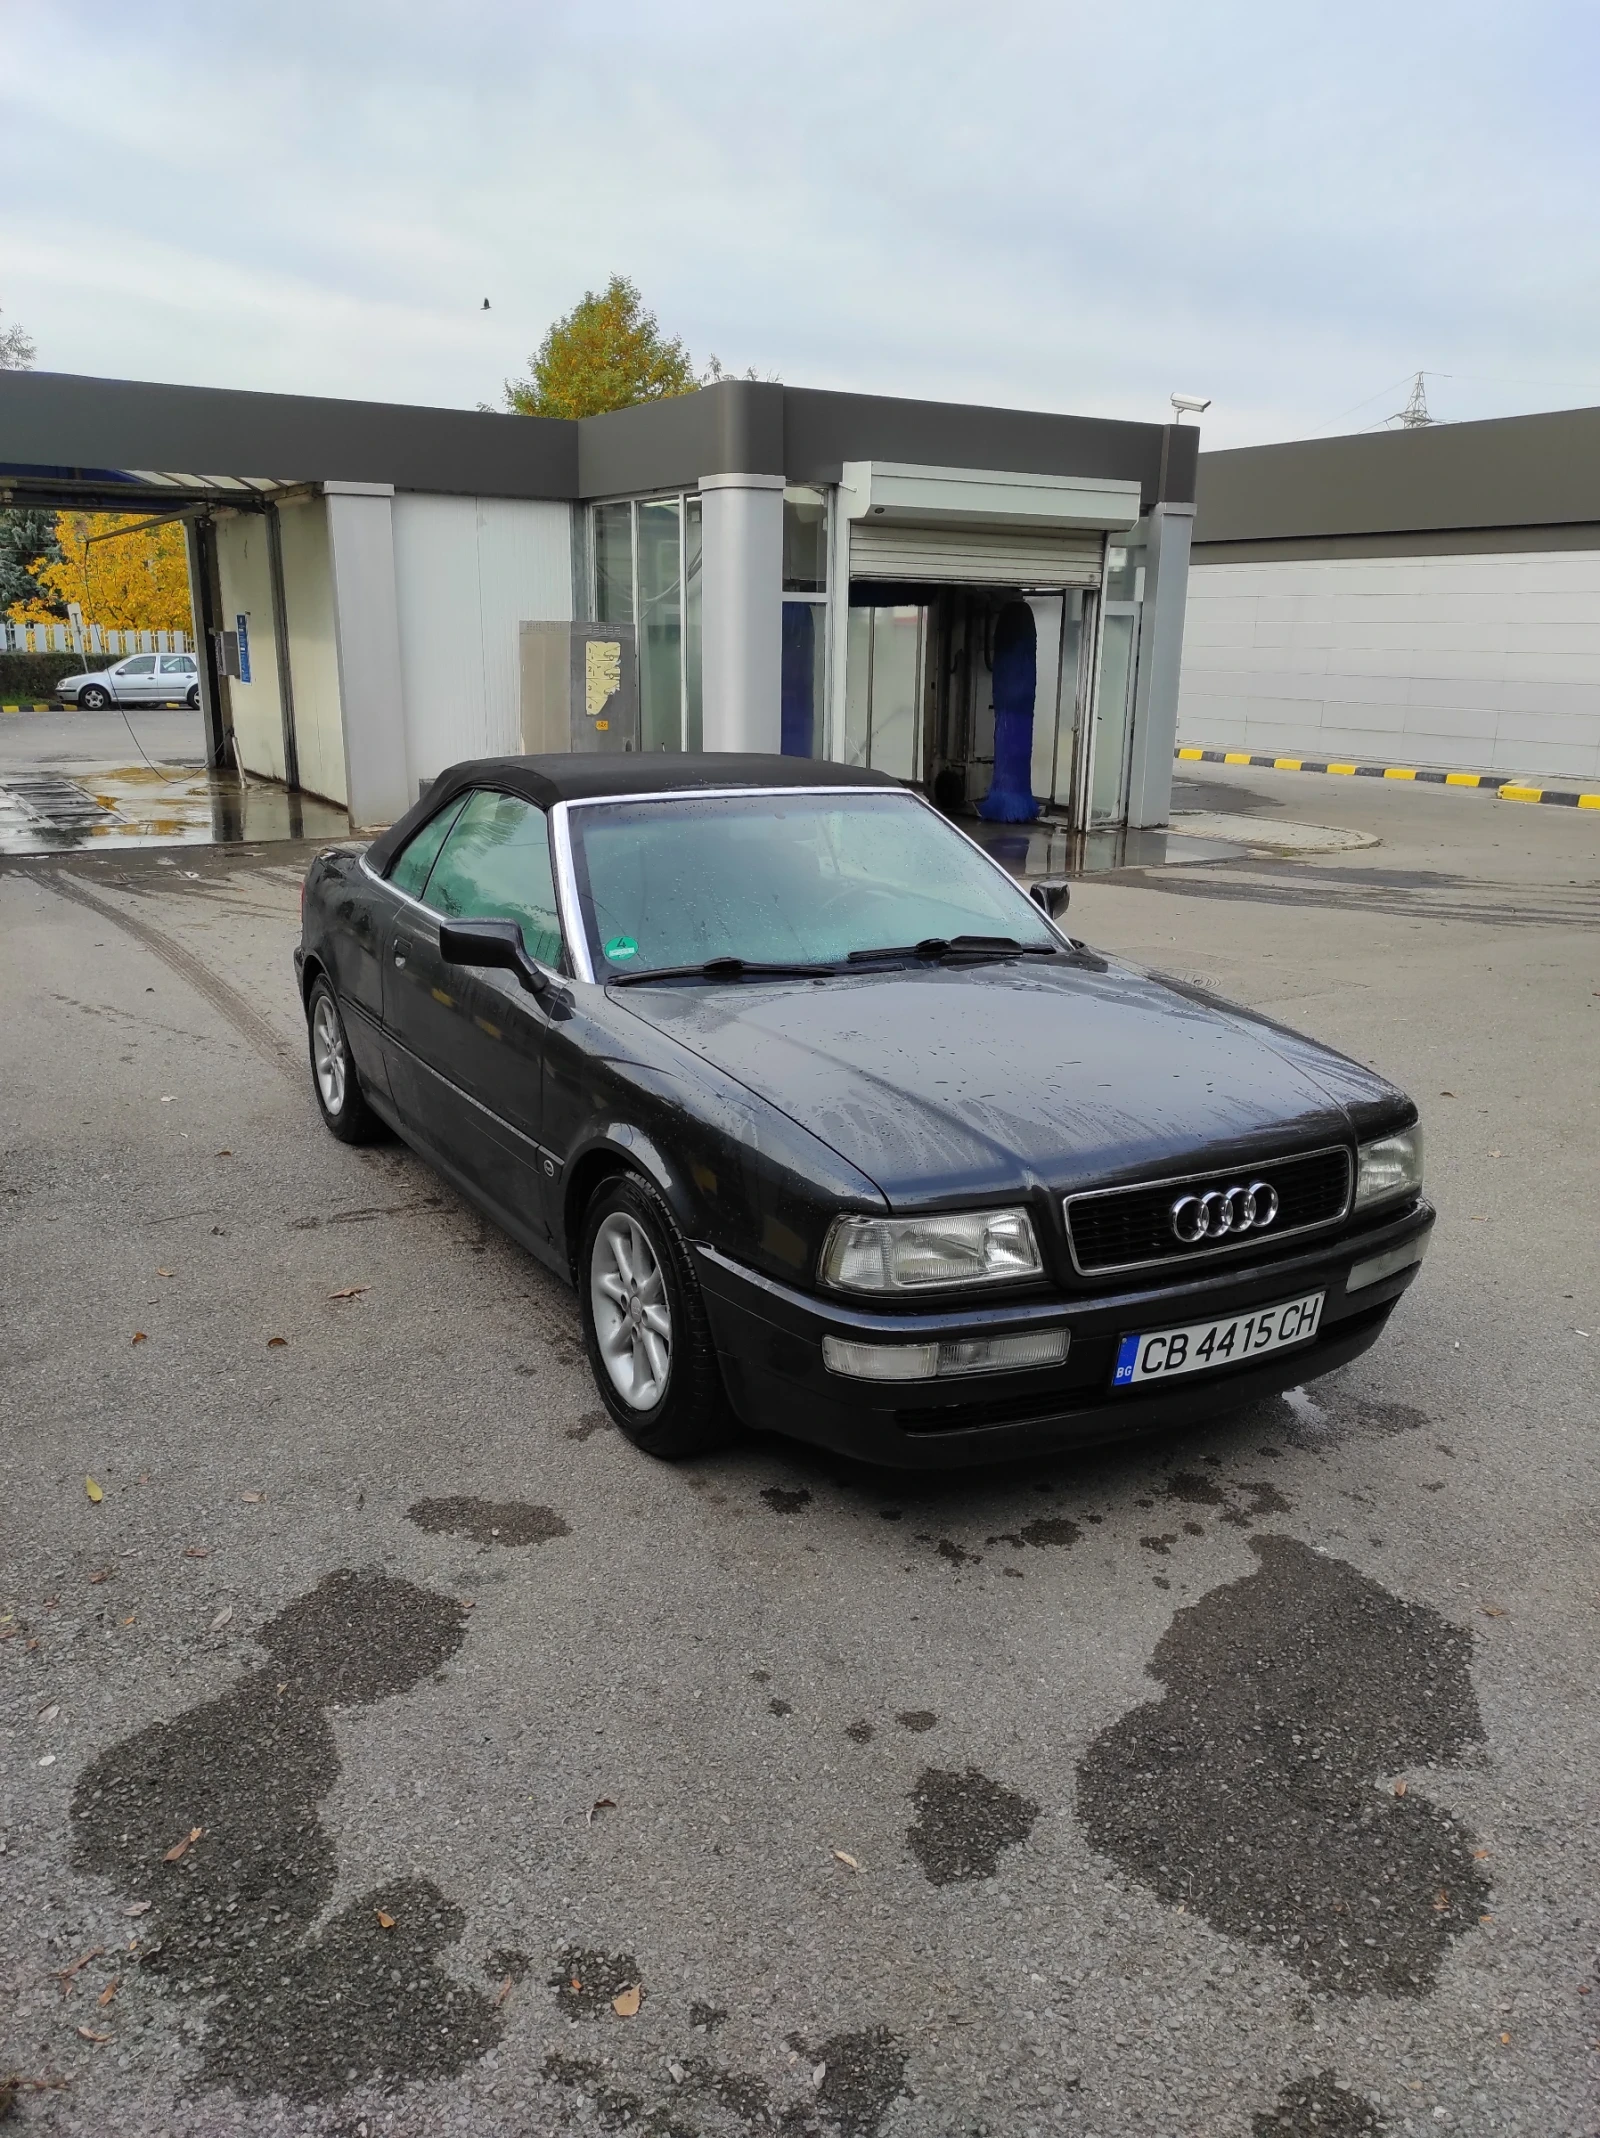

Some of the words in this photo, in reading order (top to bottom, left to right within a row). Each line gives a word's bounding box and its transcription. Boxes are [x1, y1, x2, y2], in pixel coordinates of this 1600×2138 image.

[616, 937, 627, 948] 4
[1141, 1334, 1189, 1374] CB
[1196, 1312, 1275, 1362] 4415
[1278, 1297, 1319, 1340] CH
[1116, 1365, 1132, 1379] BG
